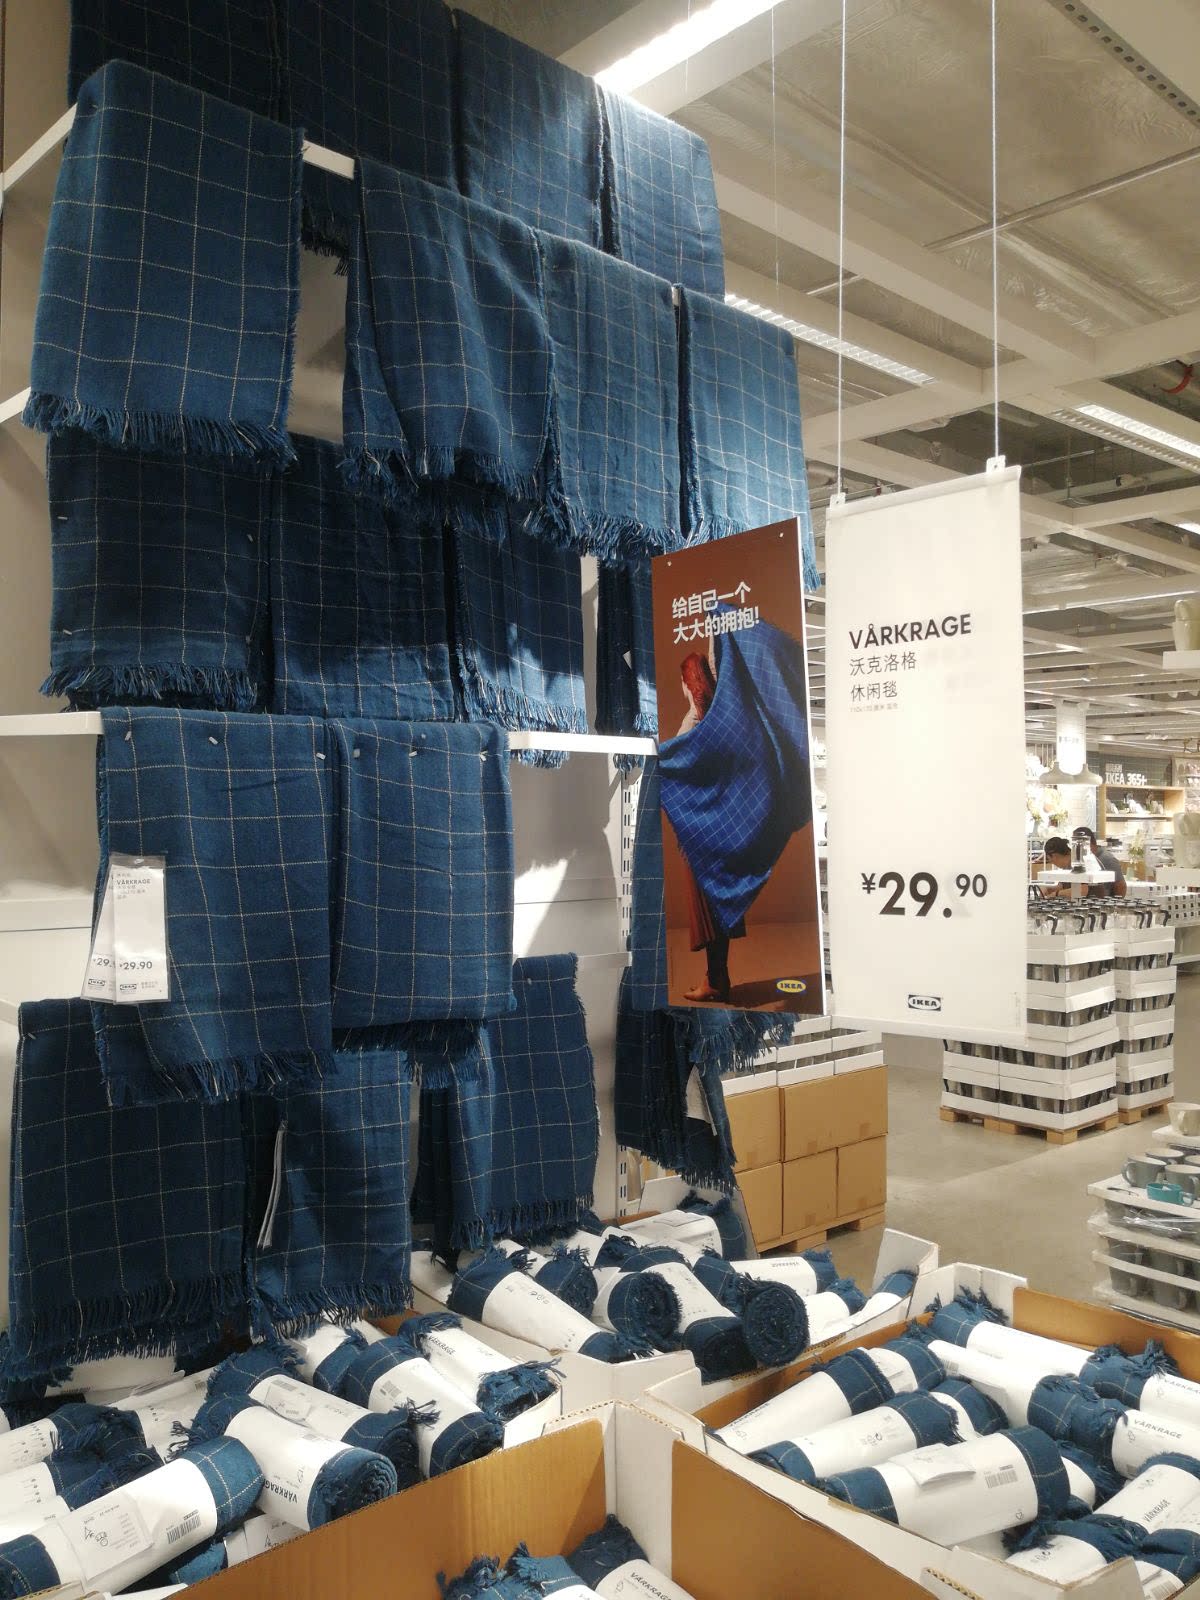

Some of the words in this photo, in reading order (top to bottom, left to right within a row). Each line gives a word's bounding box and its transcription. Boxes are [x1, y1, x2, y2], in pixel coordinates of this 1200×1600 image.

[672, 582, 751, 618] 给自己一个
[849, 613, 971, 649] VÅRKRAGE
[849, 651, 917, 677] 沃克洛格
[850, 680, 897, 702] 休闲毯
[1105, 772, 1125, 785] IKEA
[1134, 1419, 1182, 1439] VÅRKRAGE
